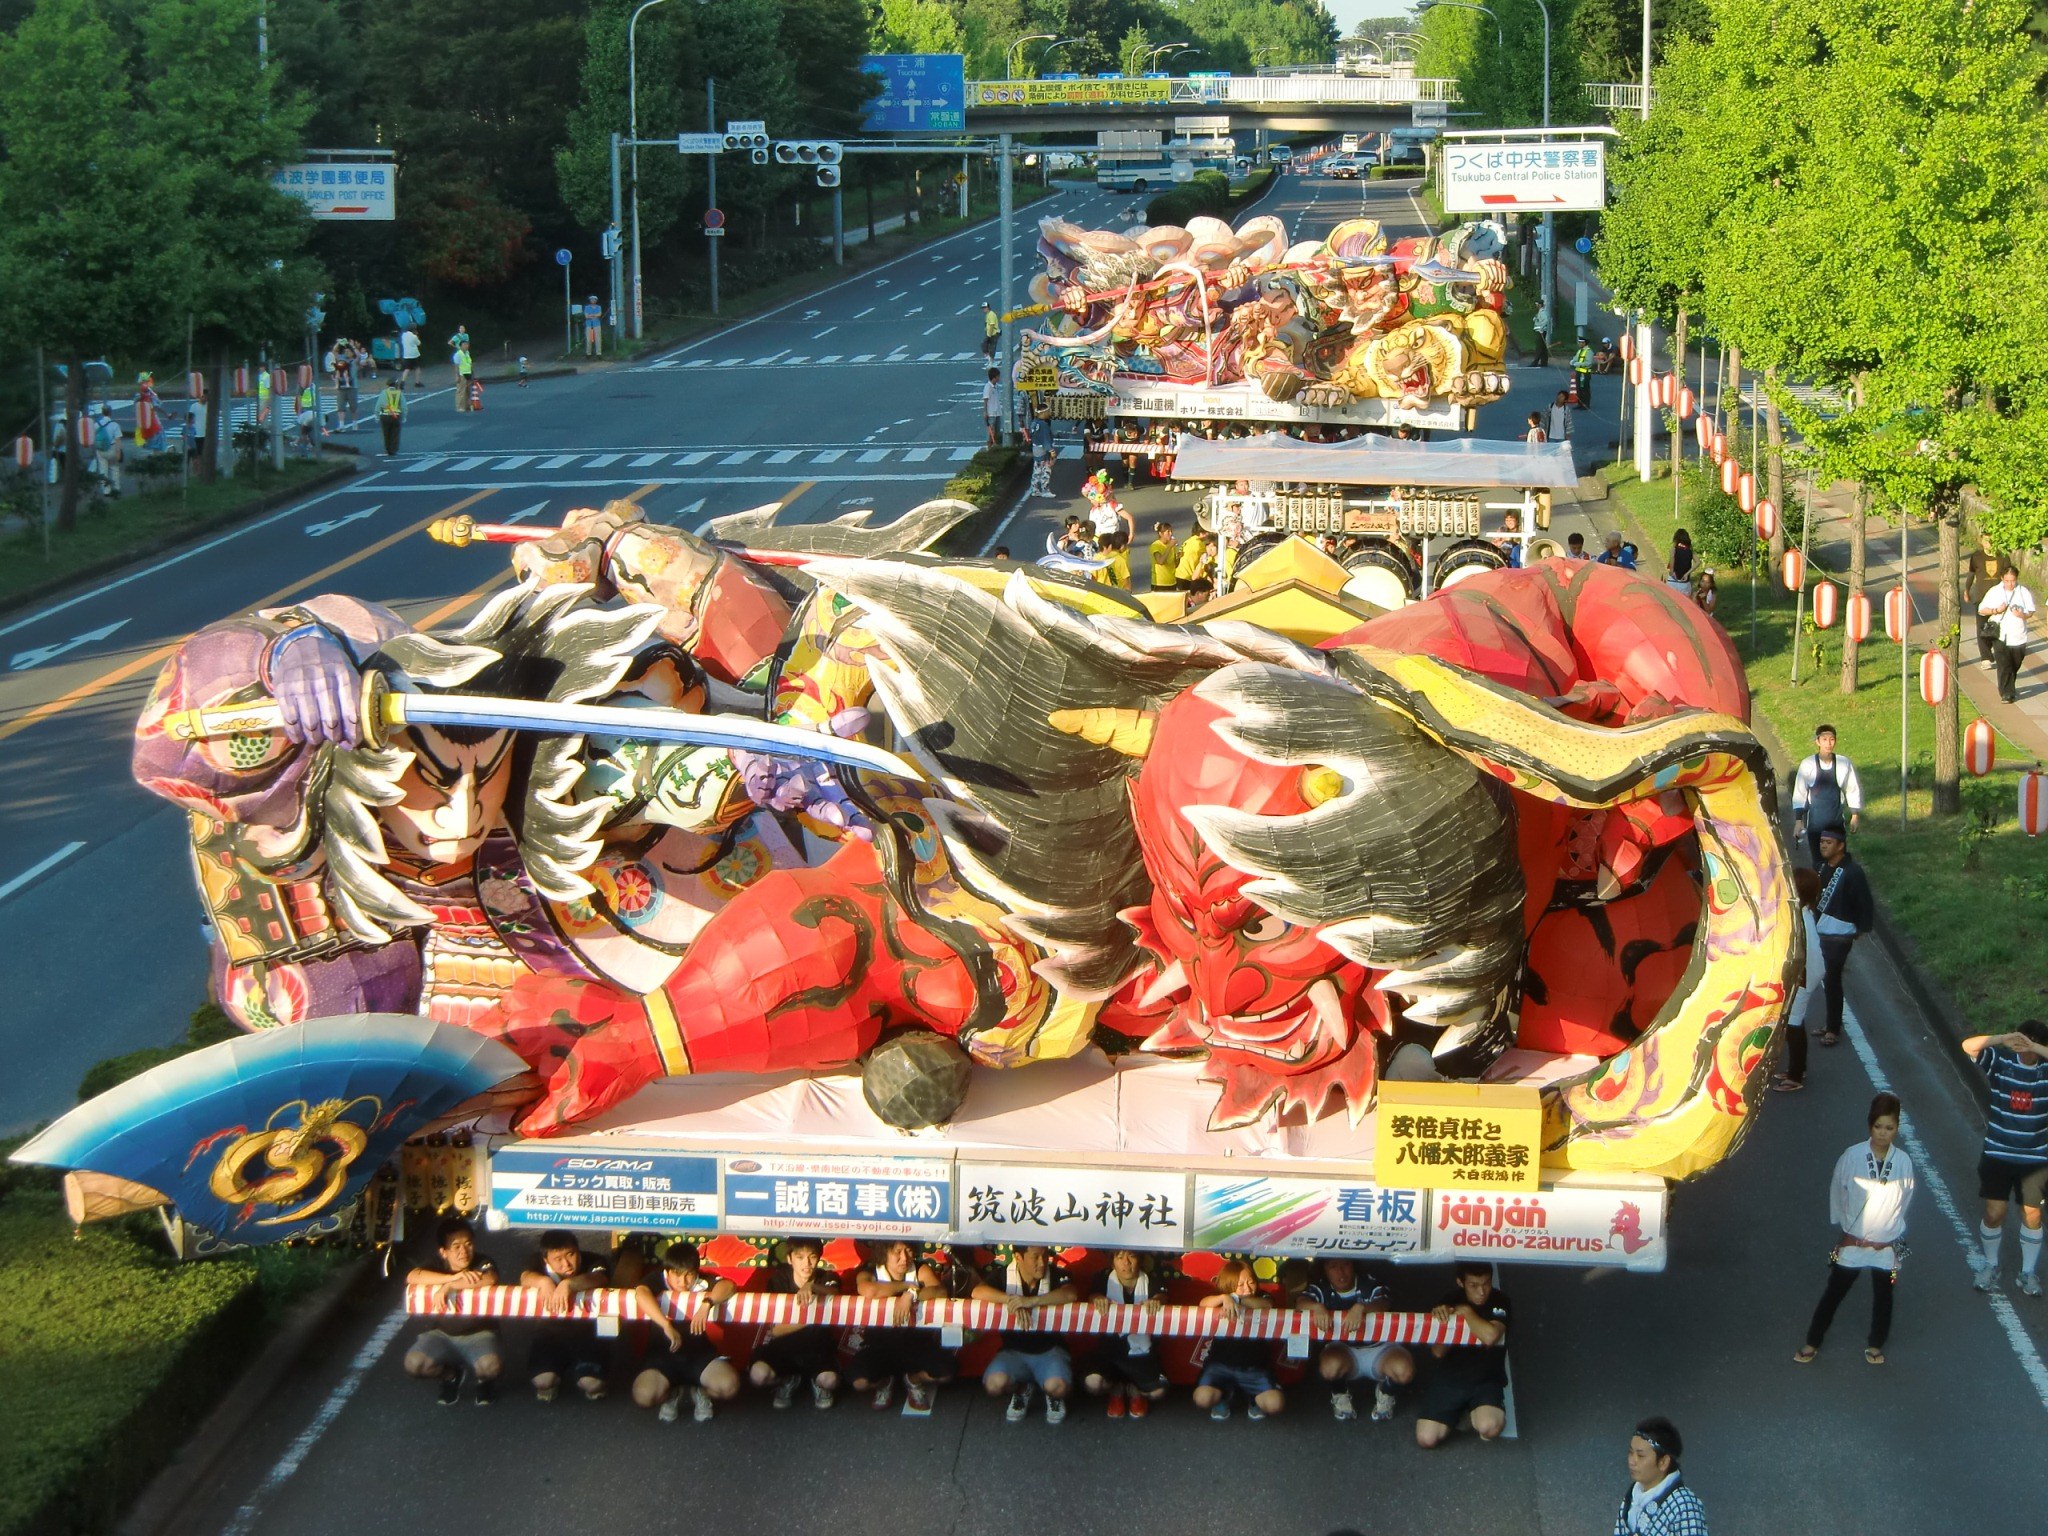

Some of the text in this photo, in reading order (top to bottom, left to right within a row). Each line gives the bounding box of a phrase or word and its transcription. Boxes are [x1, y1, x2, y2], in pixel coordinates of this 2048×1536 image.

[896, 57, 926, 69] 土浦
[1449, 149, 1598, 170] つくば中央警察署
[1452, 170, 1598, 182] Tsukuba Central Police Station
[338, 190, 358, 200] POST
[360, 190, 385, 200] OFFICE
[1133, 397, 1174, 411] 君山重機
[1180, 406, 1244, 416] ホリー株式会社
[1391, 1115, 1502, 1141] 安倍貞任と
[1395, 1141, 1530, 1168] 八幡太郎義家
[550, 1173, 671, 1191] トラック買取・販売
[525, 1193, 696, 1212] 株式会社 磯山自動車販売
[734, 1180, 941, 1219] 一誠商事（株）
[967, 1184, 1178, 1230] 筑波山神社
[1336, 1188, 1417, 1224] 看板
[526, 1211, 682, 1226] http://www.japantruck.com/
[1438, 1195, 1547, 1232] janjan
[763, 1218, 912, 1233] http://www.issei-syoji.co.jp
[1504, 1227, 1550, 1235] デルノザウルス
[1452, 1228, 1604, 1252] delno-zaurus
